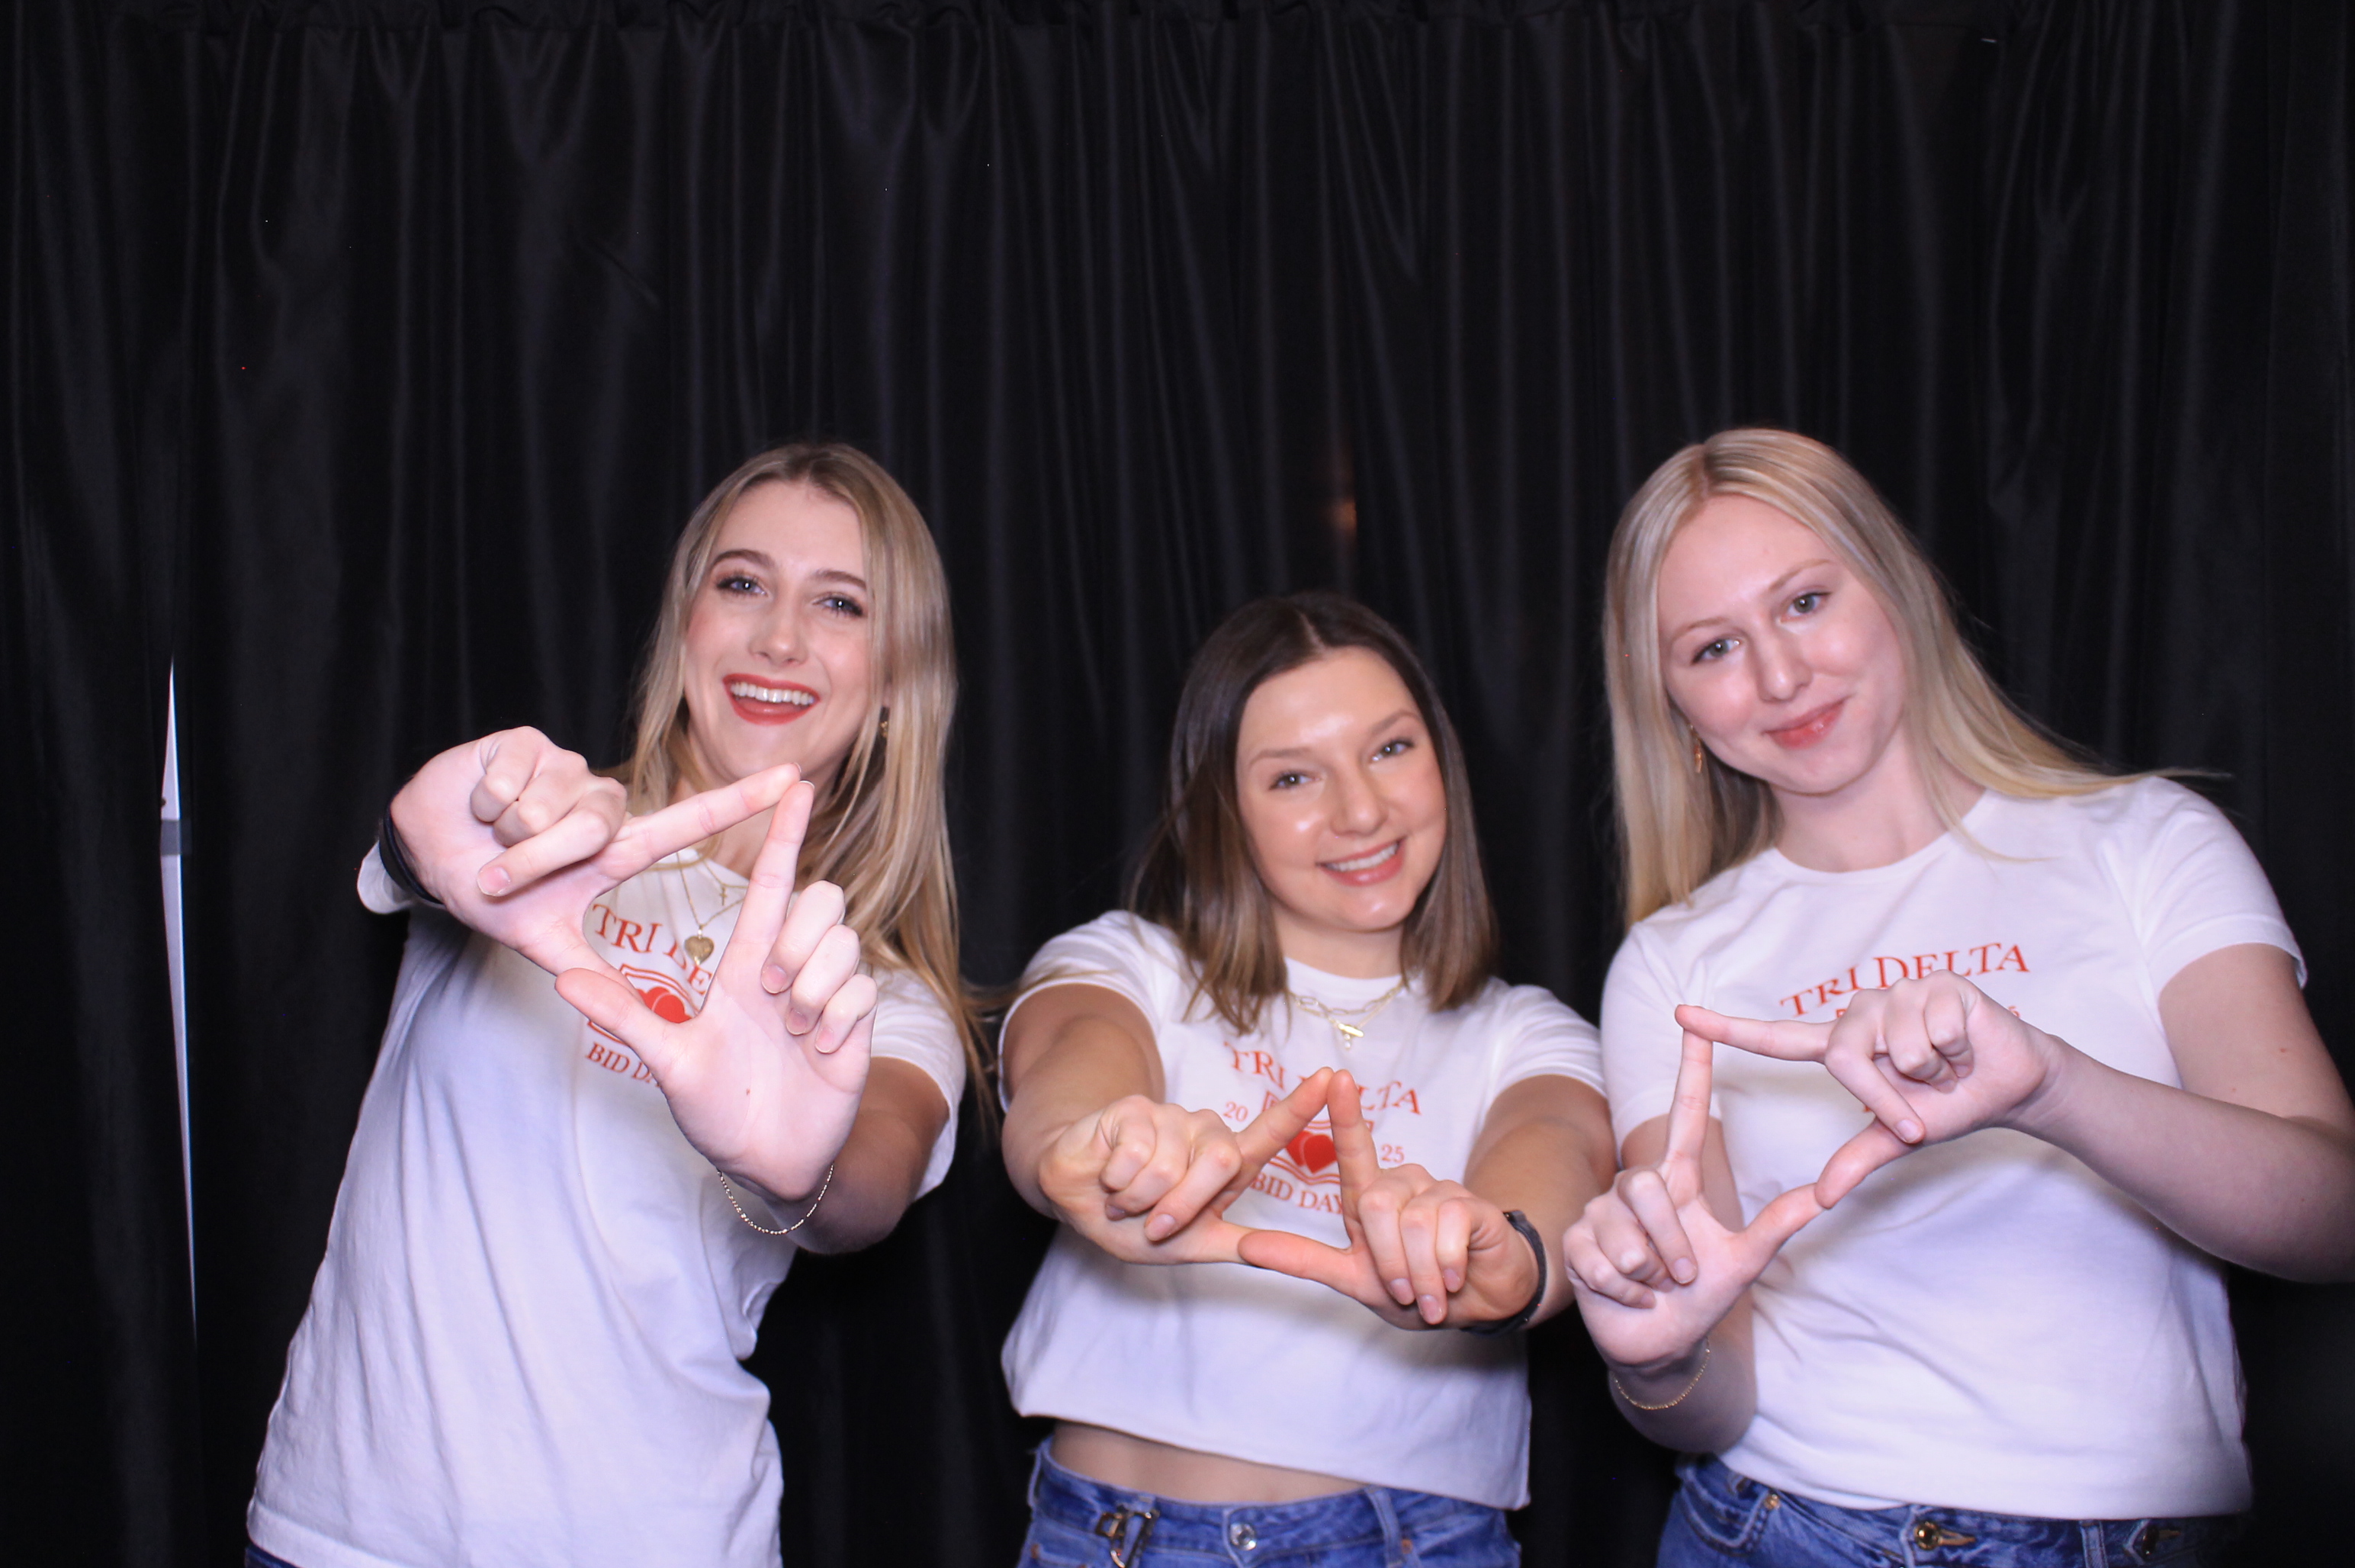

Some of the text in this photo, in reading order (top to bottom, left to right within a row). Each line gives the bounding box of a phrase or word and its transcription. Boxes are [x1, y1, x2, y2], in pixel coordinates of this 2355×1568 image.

[593, 903, 663, 953] TRI
[1780, 943, 2030, 1017] TRI DELTA
[584, 1042, 630, 1074] BID
[1224, 1042, 1286, 1091] TRI
[1223, 1101, 1248, 1122] 20
[1381, 1144, 1405, 1163] 25
[1251, 1173, 1293, 1201] BID
